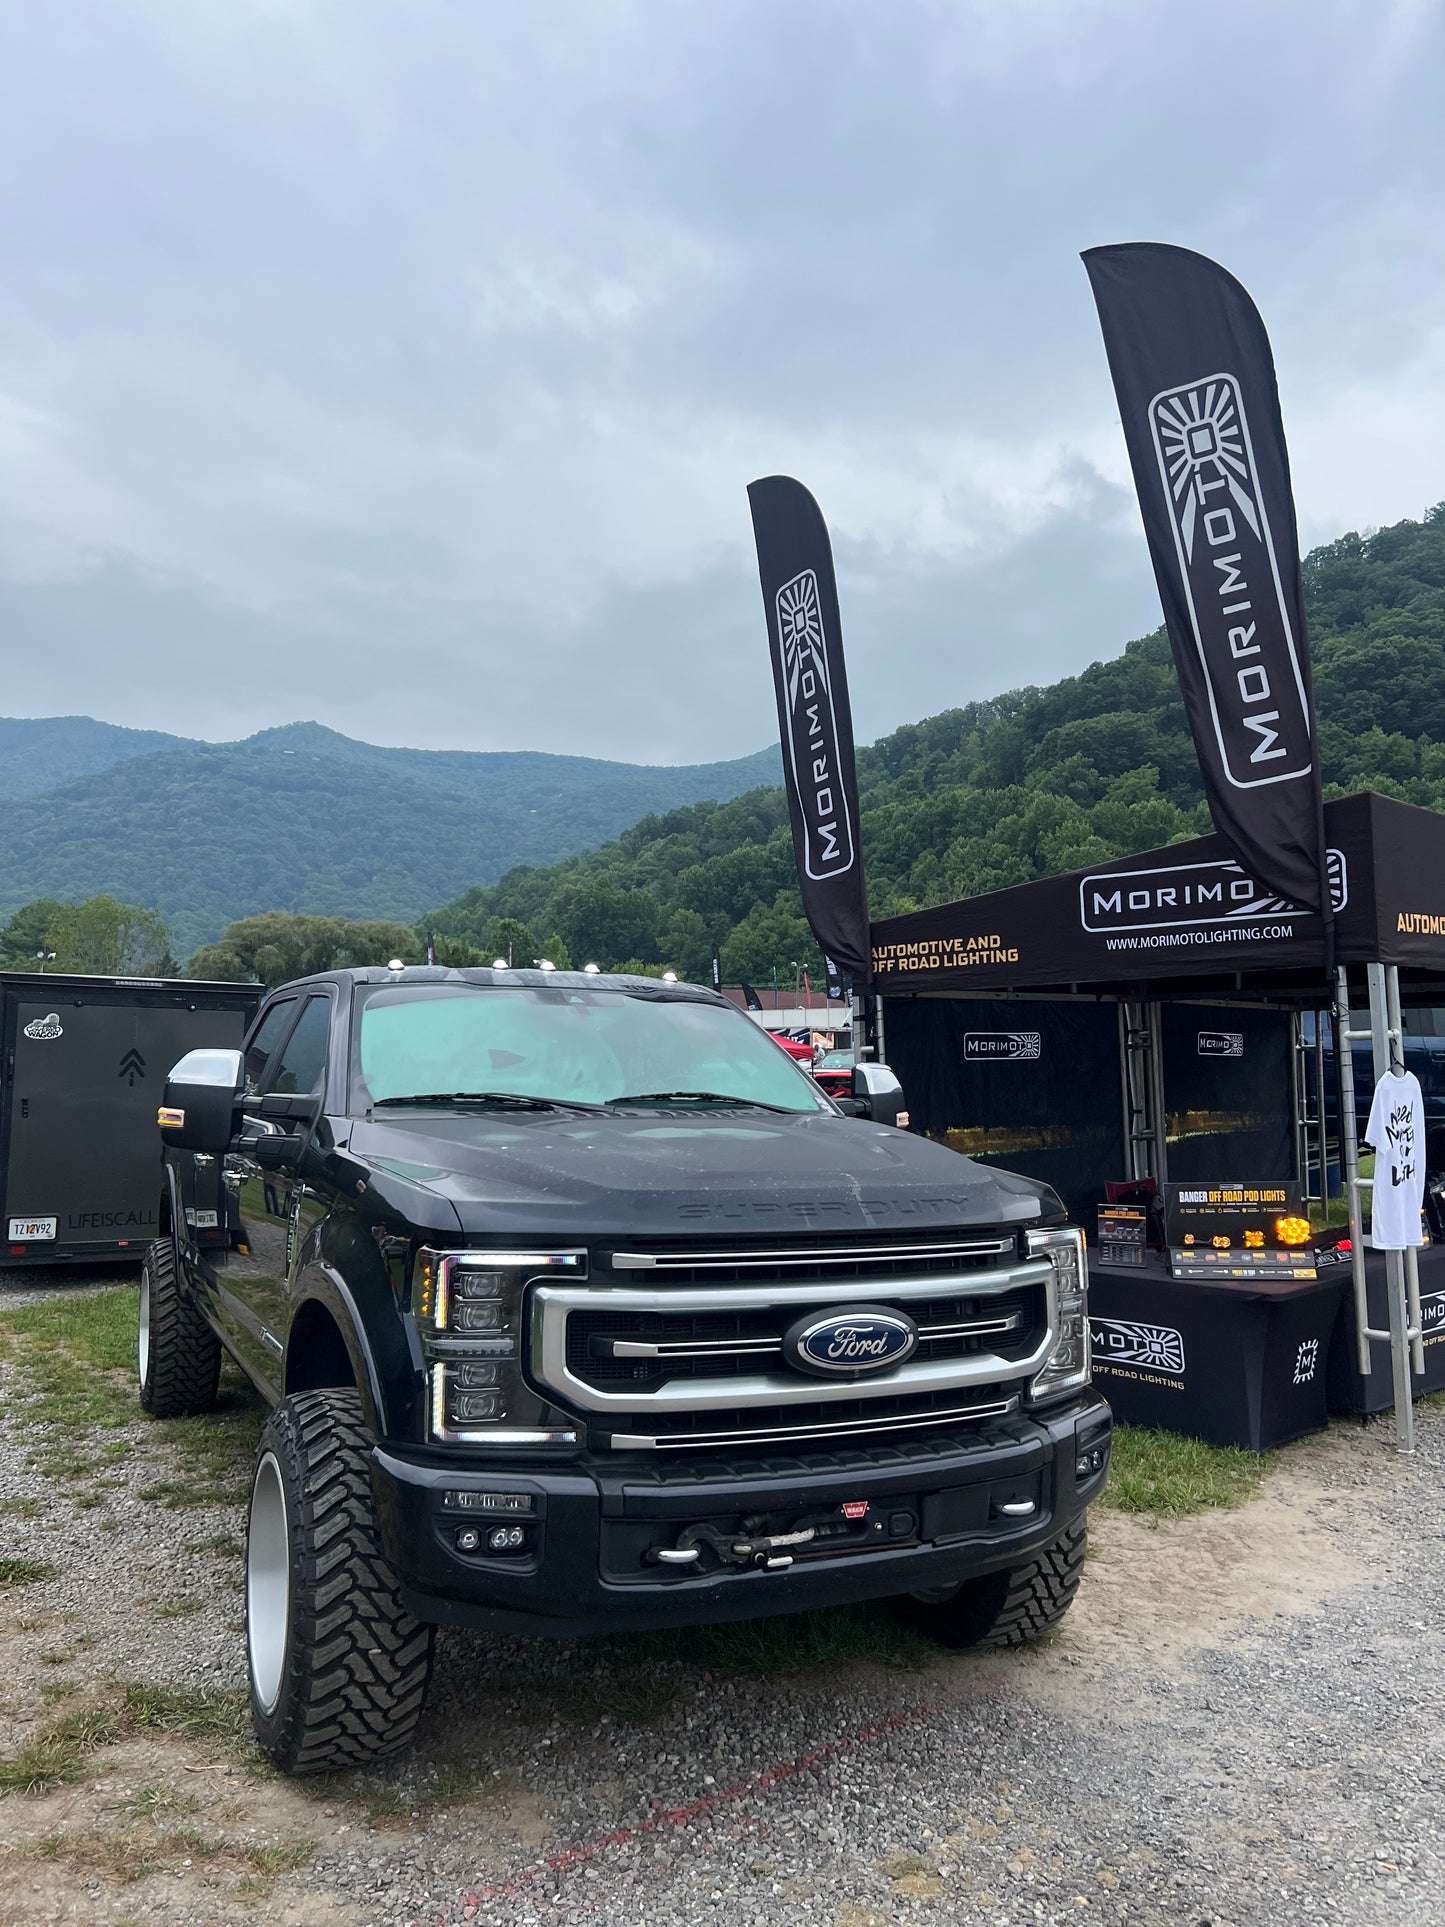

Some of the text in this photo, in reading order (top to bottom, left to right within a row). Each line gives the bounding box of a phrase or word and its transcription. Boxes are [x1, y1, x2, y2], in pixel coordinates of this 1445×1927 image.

[1093, 880, 1254, 915] MORIMO
[1396, 912, 1445, 935] AUTOMO
[872, 934, 1001, 959] AUTOMOTIVE AND
[1106, 925, 1293, 951] WWW.MORIMOTOLIGHTING.COM
[898, 955, 940, 971] ROAD
[943, 948, 1019, 967] LIGHTING
[1179, 1190, 1286, 1203] BANGER OFF ROAD POD LIGHTS
[828, 1326, 889, 1358] Ford
[1301, 1354, 1311, 1369] M
[1092, 1365, 1185, 1390] OFF ROAD LIGHTING
